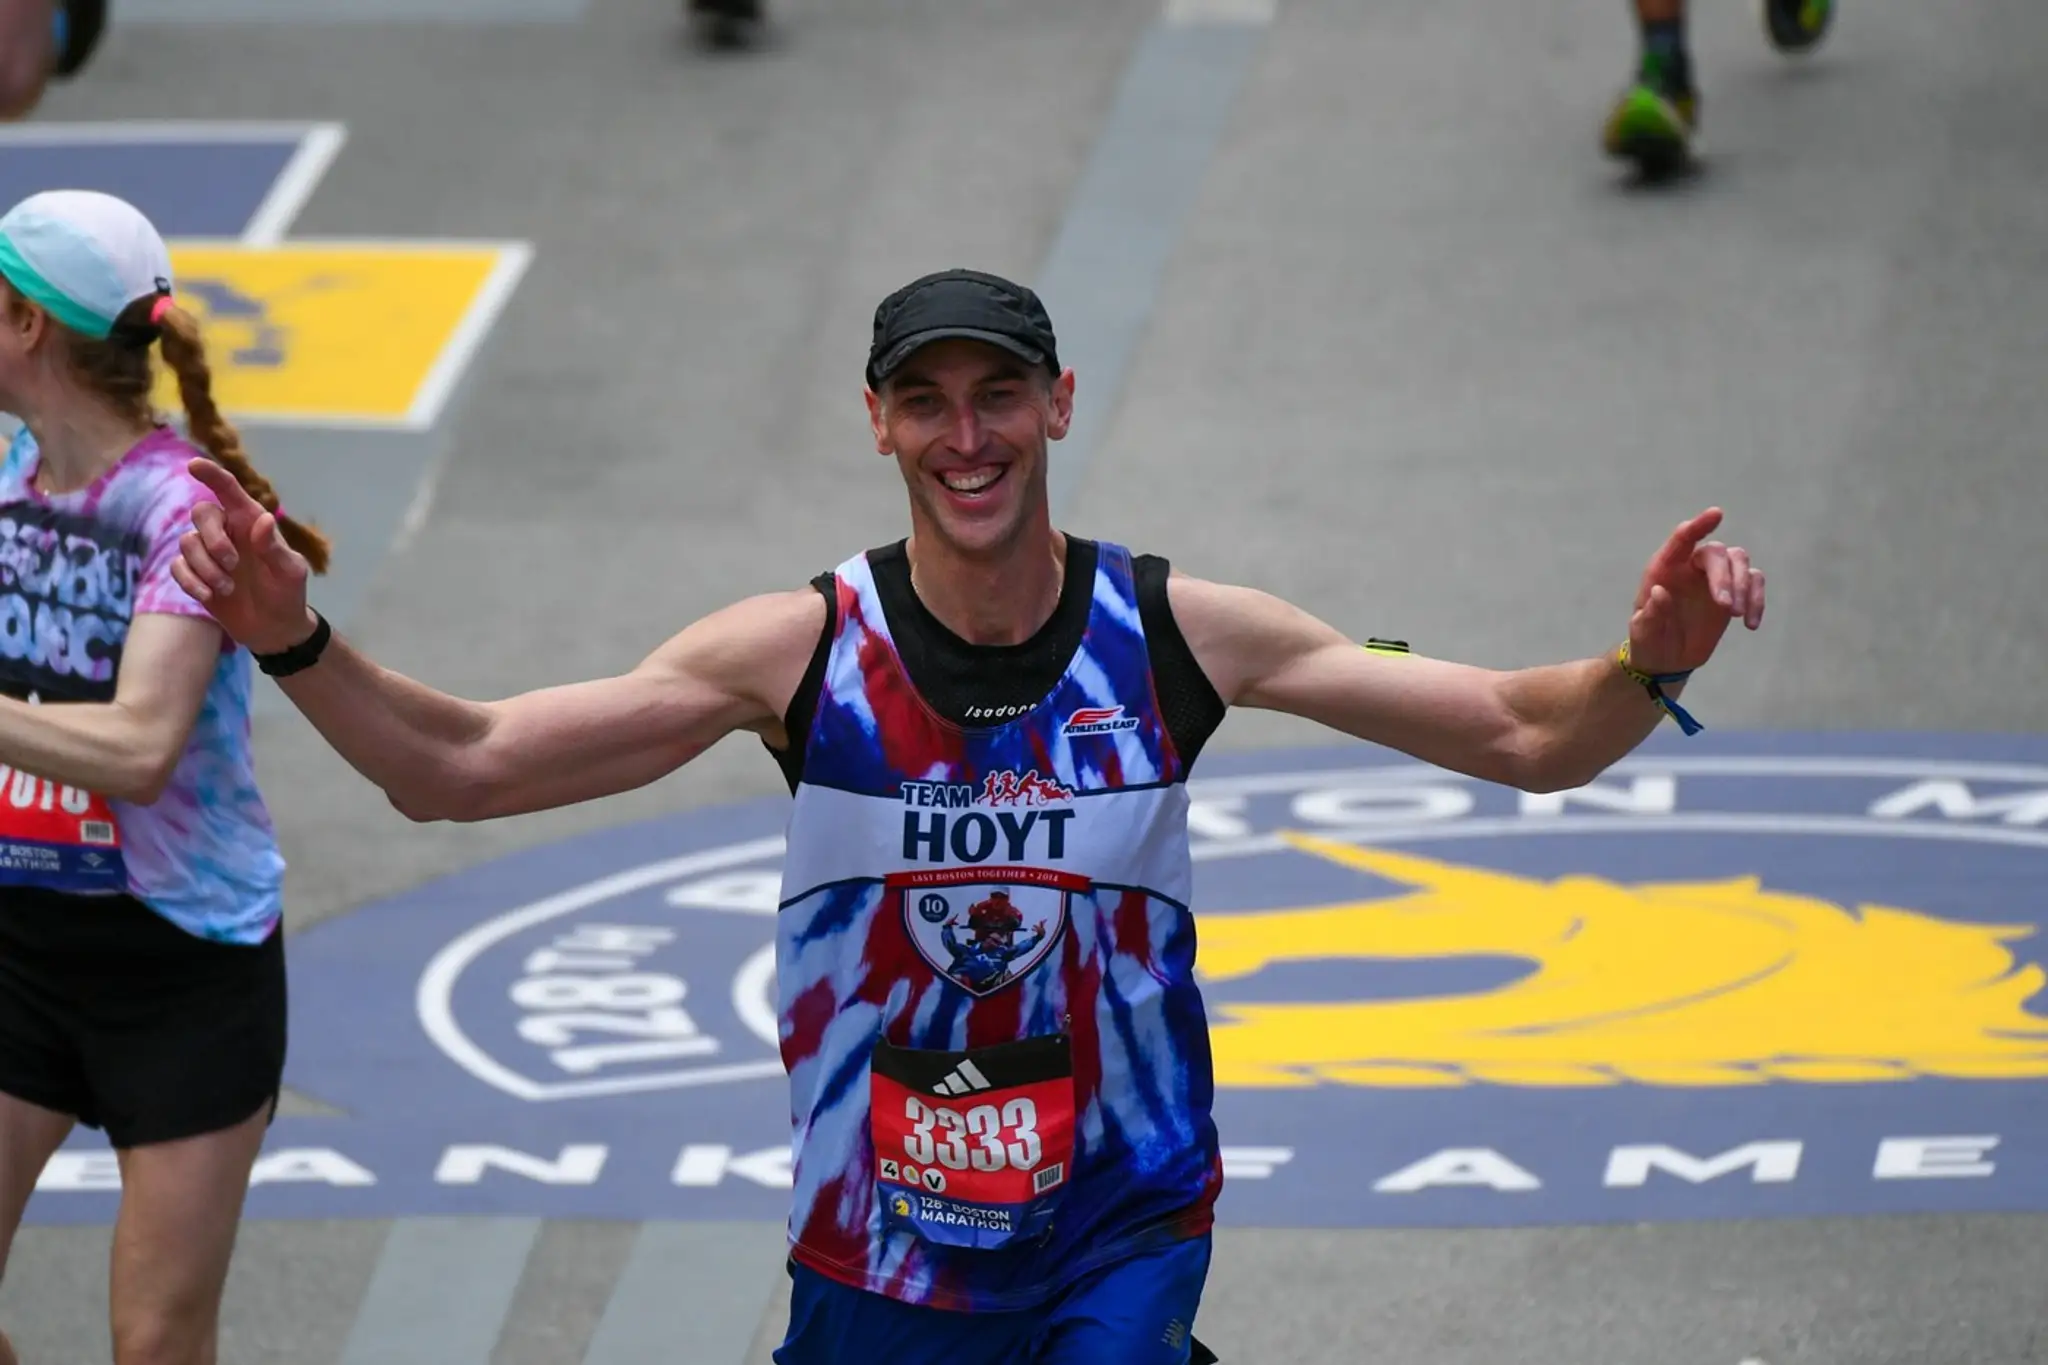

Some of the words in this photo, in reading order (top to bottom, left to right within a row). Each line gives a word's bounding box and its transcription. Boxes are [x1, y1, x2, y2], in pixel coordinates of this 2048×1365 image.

[1112, 719, 1137, 730] EAST
[902, 783, 972, 808] TEAM
[903, 809, 1075, 862] HOYT
[912, 874, 933, 883] LAST
[936, 873, 974, 881] BOSTON
[977, 870, 1027, 879] TOGETHER
[925, 898, 944, 914] 10
[903, 1096, 1042, 1172] 3333
[883, 1161, 898, 1178] 4
[925, 1174, 942, 1190] V
[952, 1202, 1010, 1220] BOSTON
[920, 1210, 1012, 1232] MARATHON
